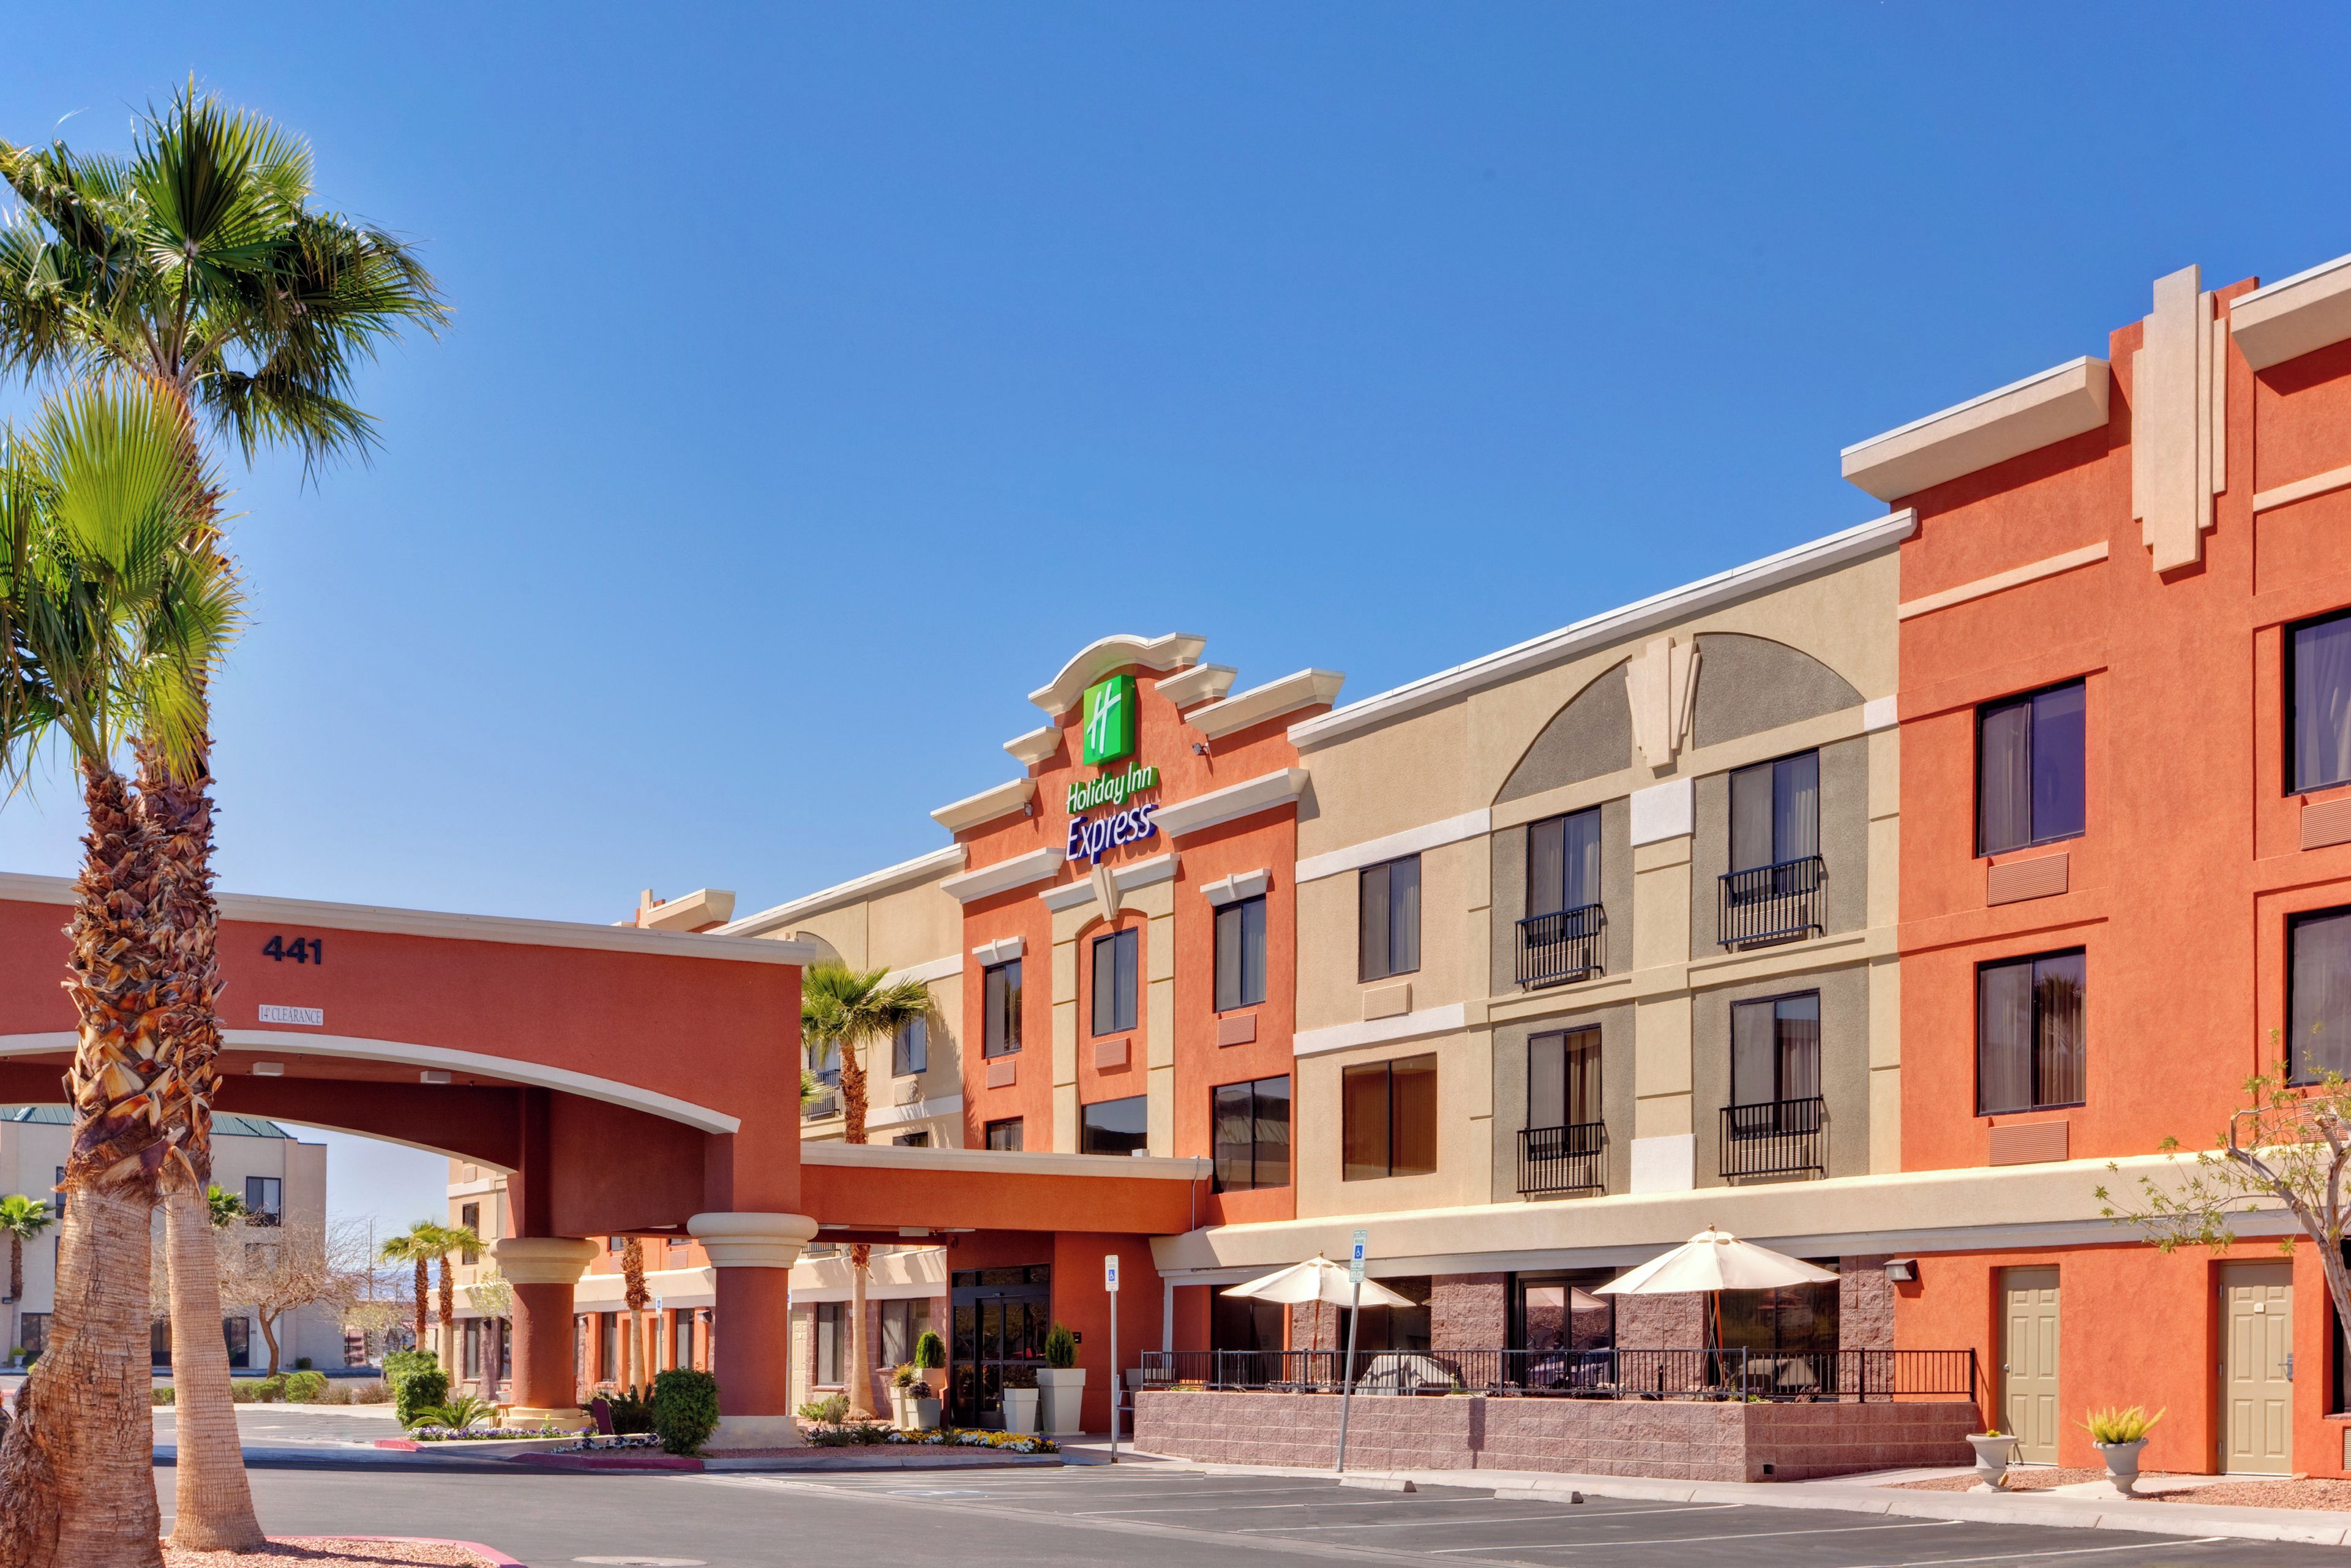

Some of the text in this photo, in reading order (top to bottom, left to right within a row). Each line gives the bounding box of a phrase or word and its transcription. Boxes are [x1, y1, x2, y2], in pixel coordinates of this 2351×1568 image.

[1066, 761, 1153, 814] Holiday Inn
[1066, 803, 1155, 865] Express
[262, 936, 322, 965] 441
[271, 1007, 321, 1024] CLEARANCE
